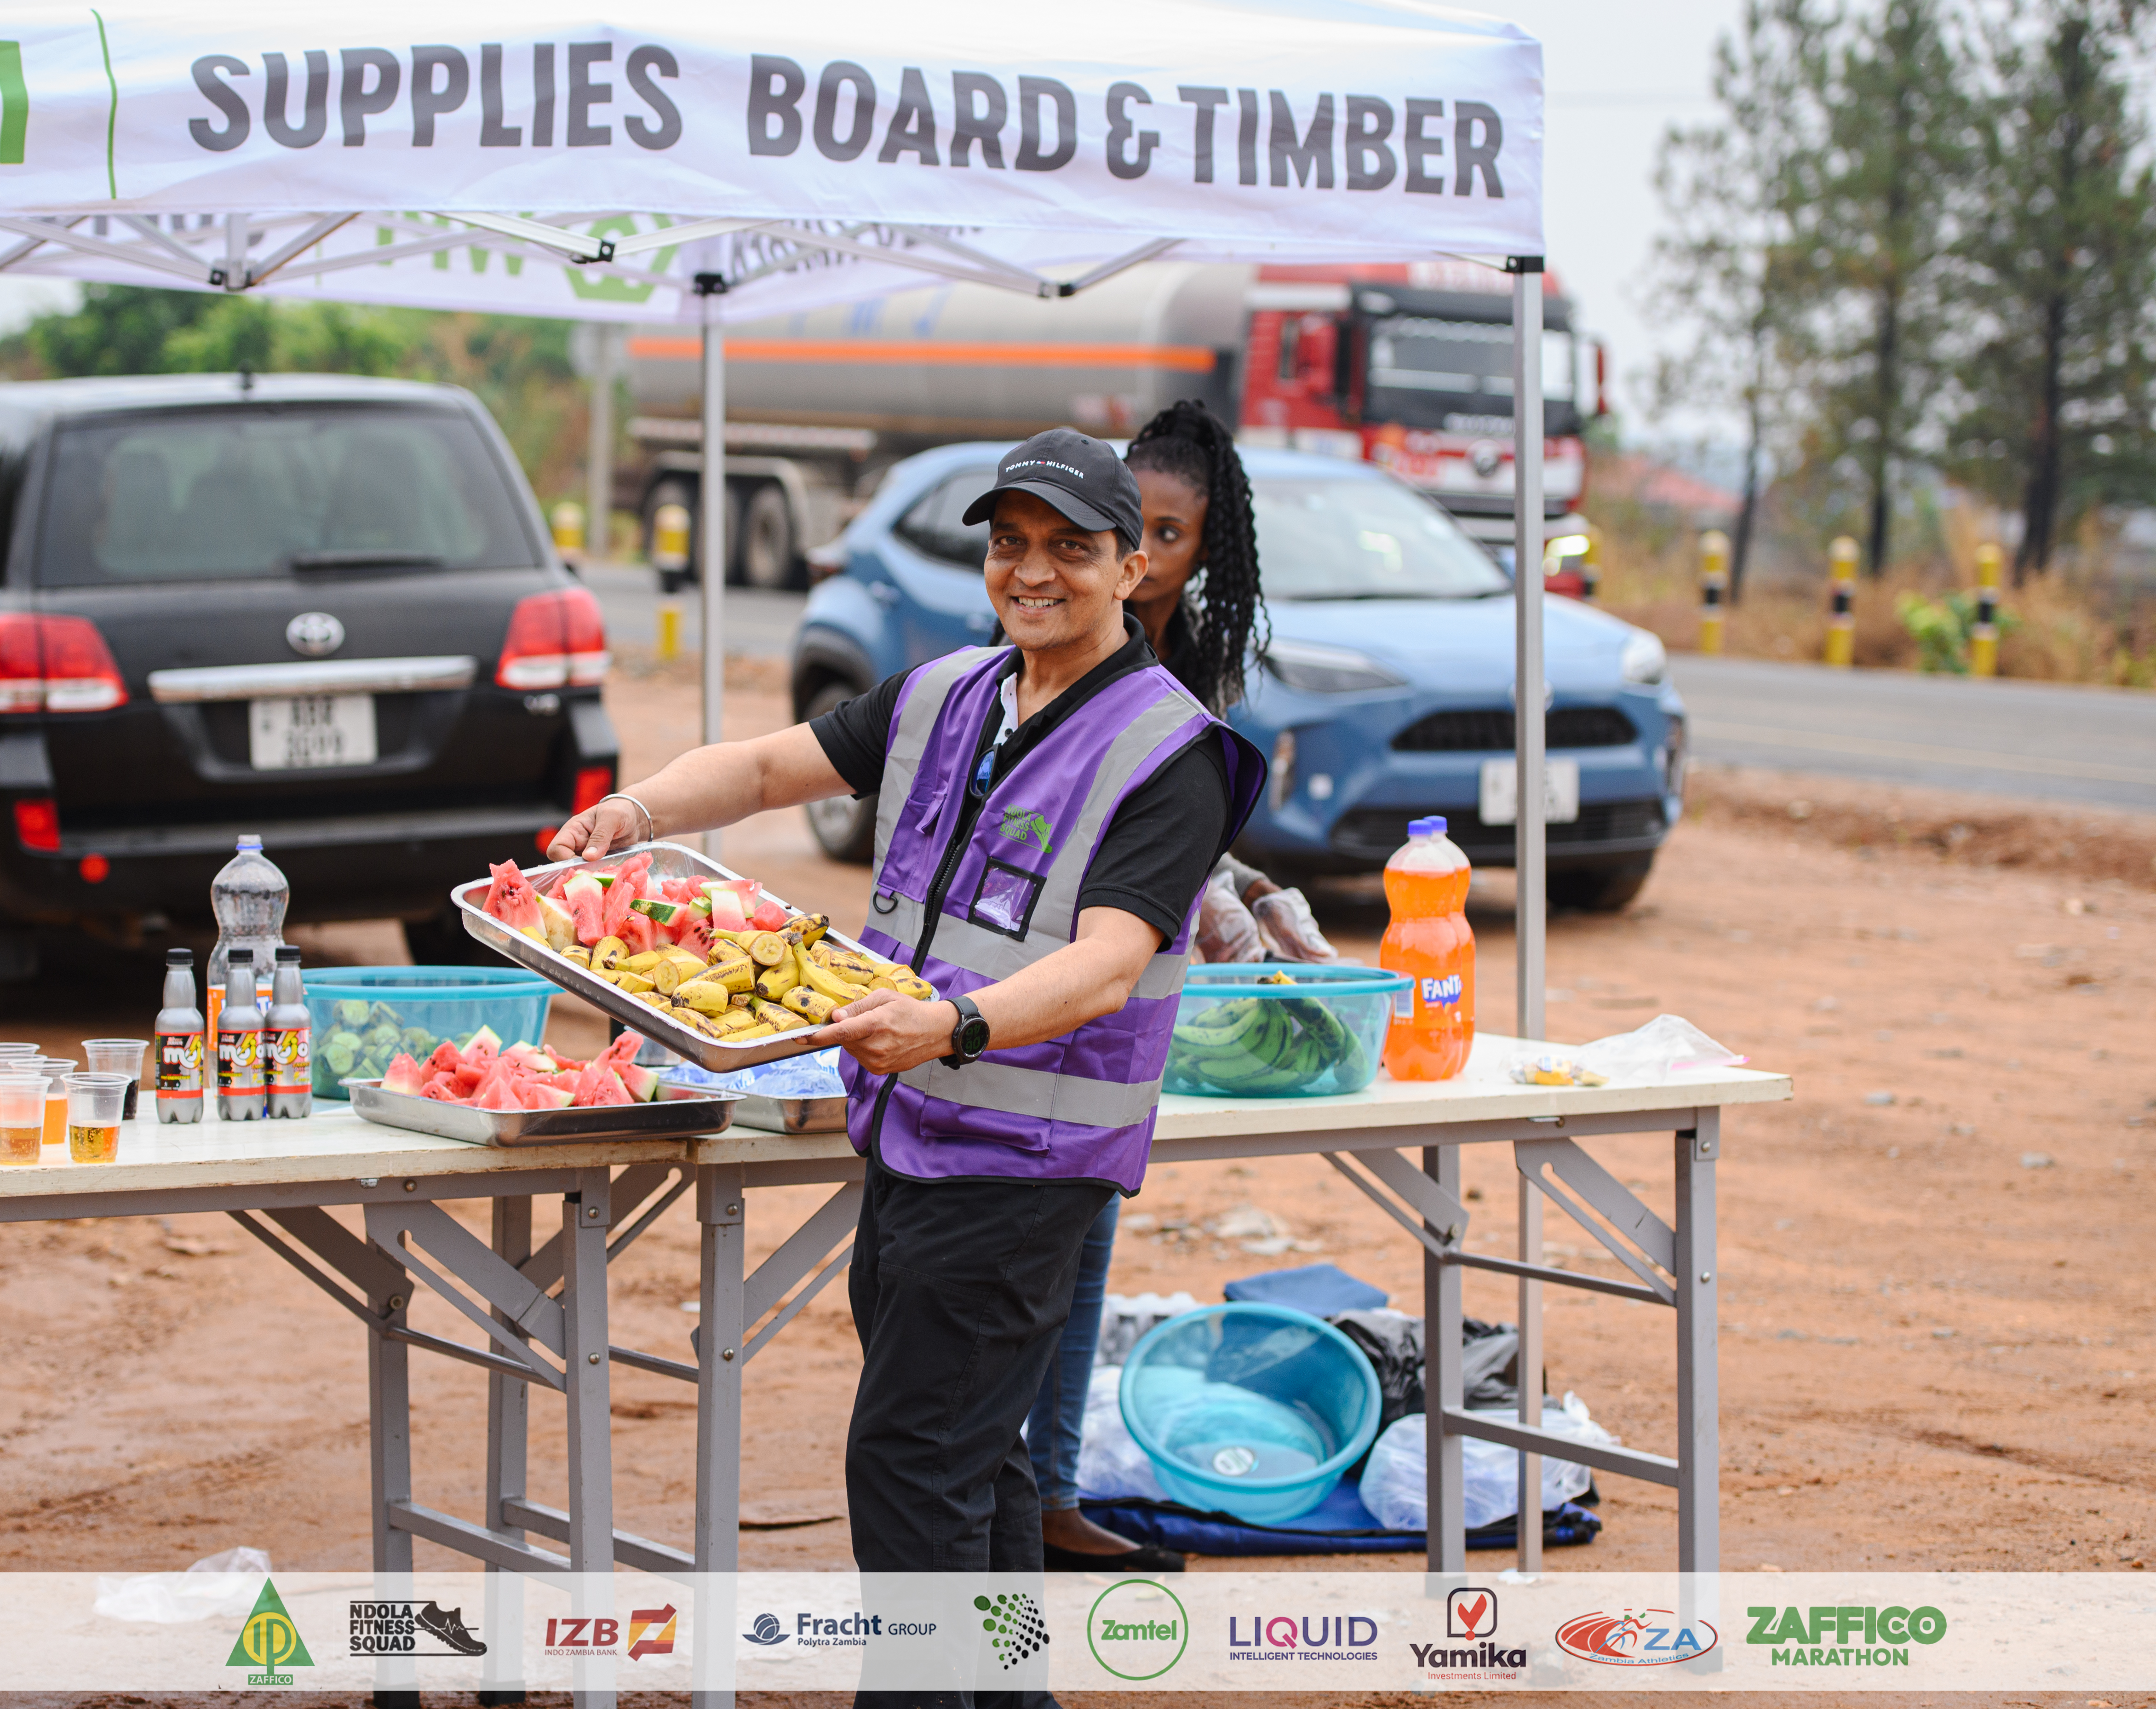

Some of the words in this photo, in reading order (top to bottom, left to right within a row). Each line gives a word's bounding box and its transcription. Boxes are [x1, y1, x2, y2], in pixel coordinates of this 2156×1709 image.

[188, 42, 682, 152] SUPPLIES
[747, 54, 1077, 172] BOARD
[1106, 81, 1160, 180] &
[1176, 85, 1506, 199] TIMBER
[1005, 460, 1035, 473] TOMMY
[1046, 460, 1084, 479] HILFIGER
[1006, 805, 1032, 821] NDOLA
[1000, 823, 1027, 841] SQUAD
[1003, 814, 1030, 832] FITNESS
